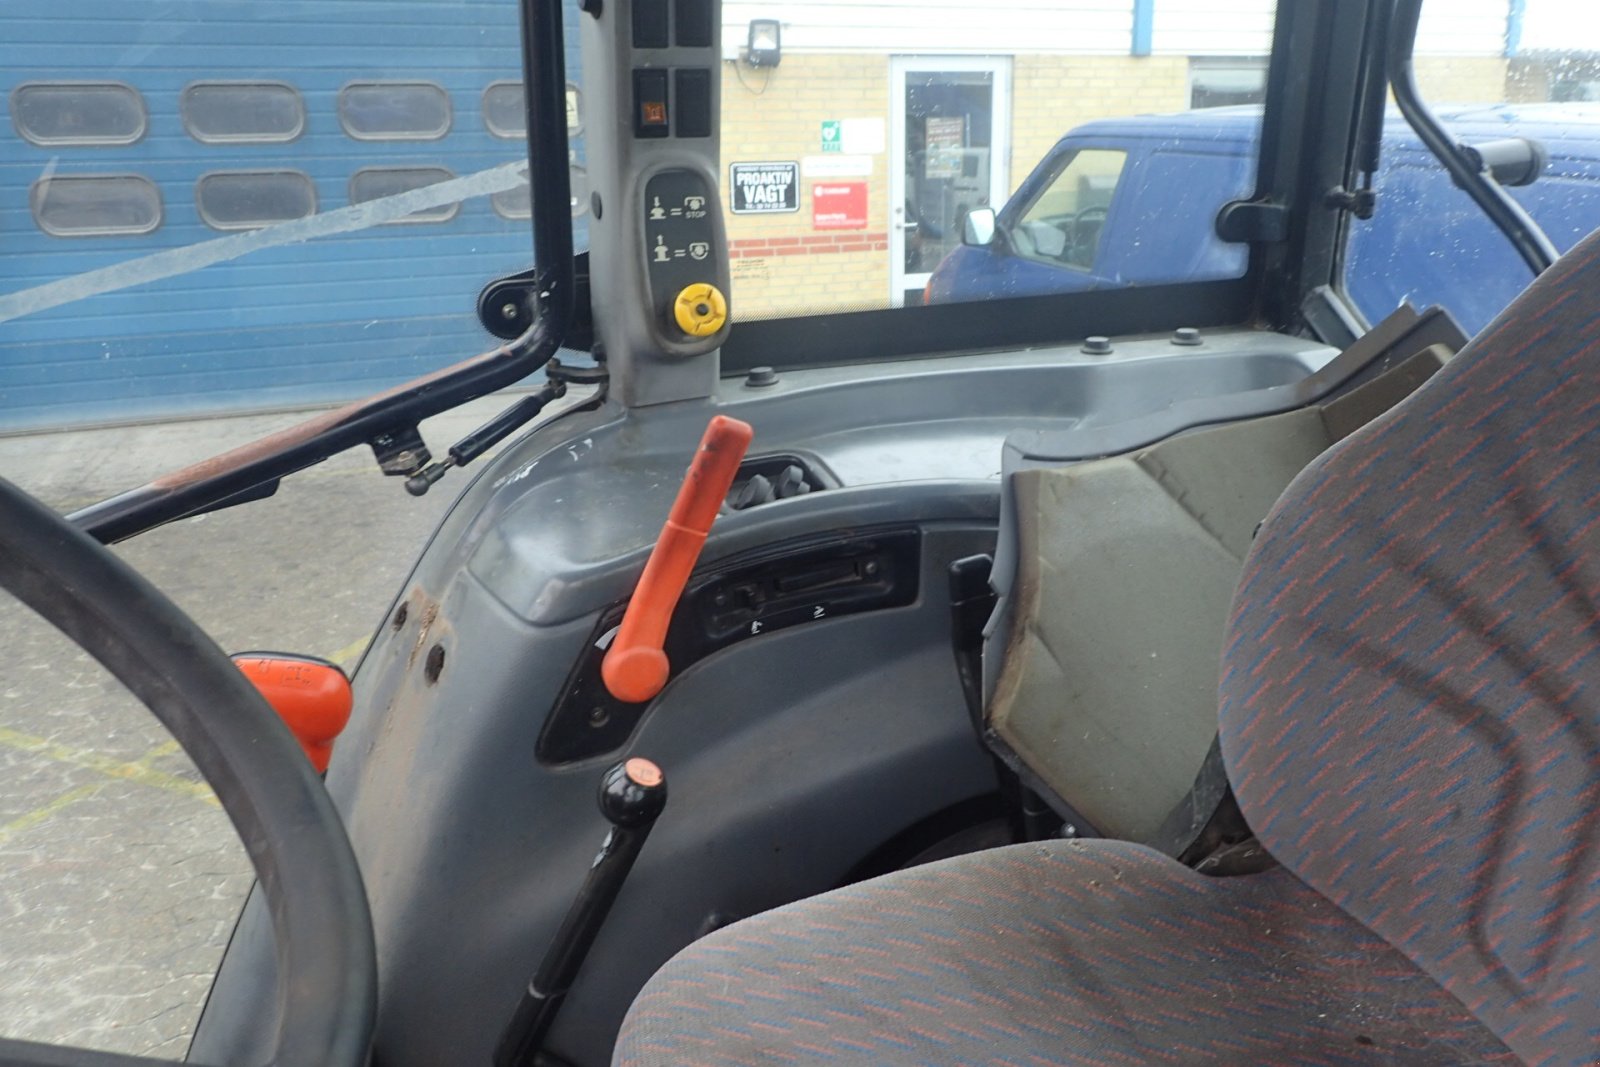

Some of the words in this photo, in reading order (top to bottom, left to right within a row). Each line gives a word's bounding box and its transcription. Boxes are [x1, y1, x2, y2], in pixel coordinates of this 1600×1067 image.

[737, 171, 793, 186] PROAKTIV
[743, 184, 788, 203] VAGT
[685, 210, 706, 219] STOP
